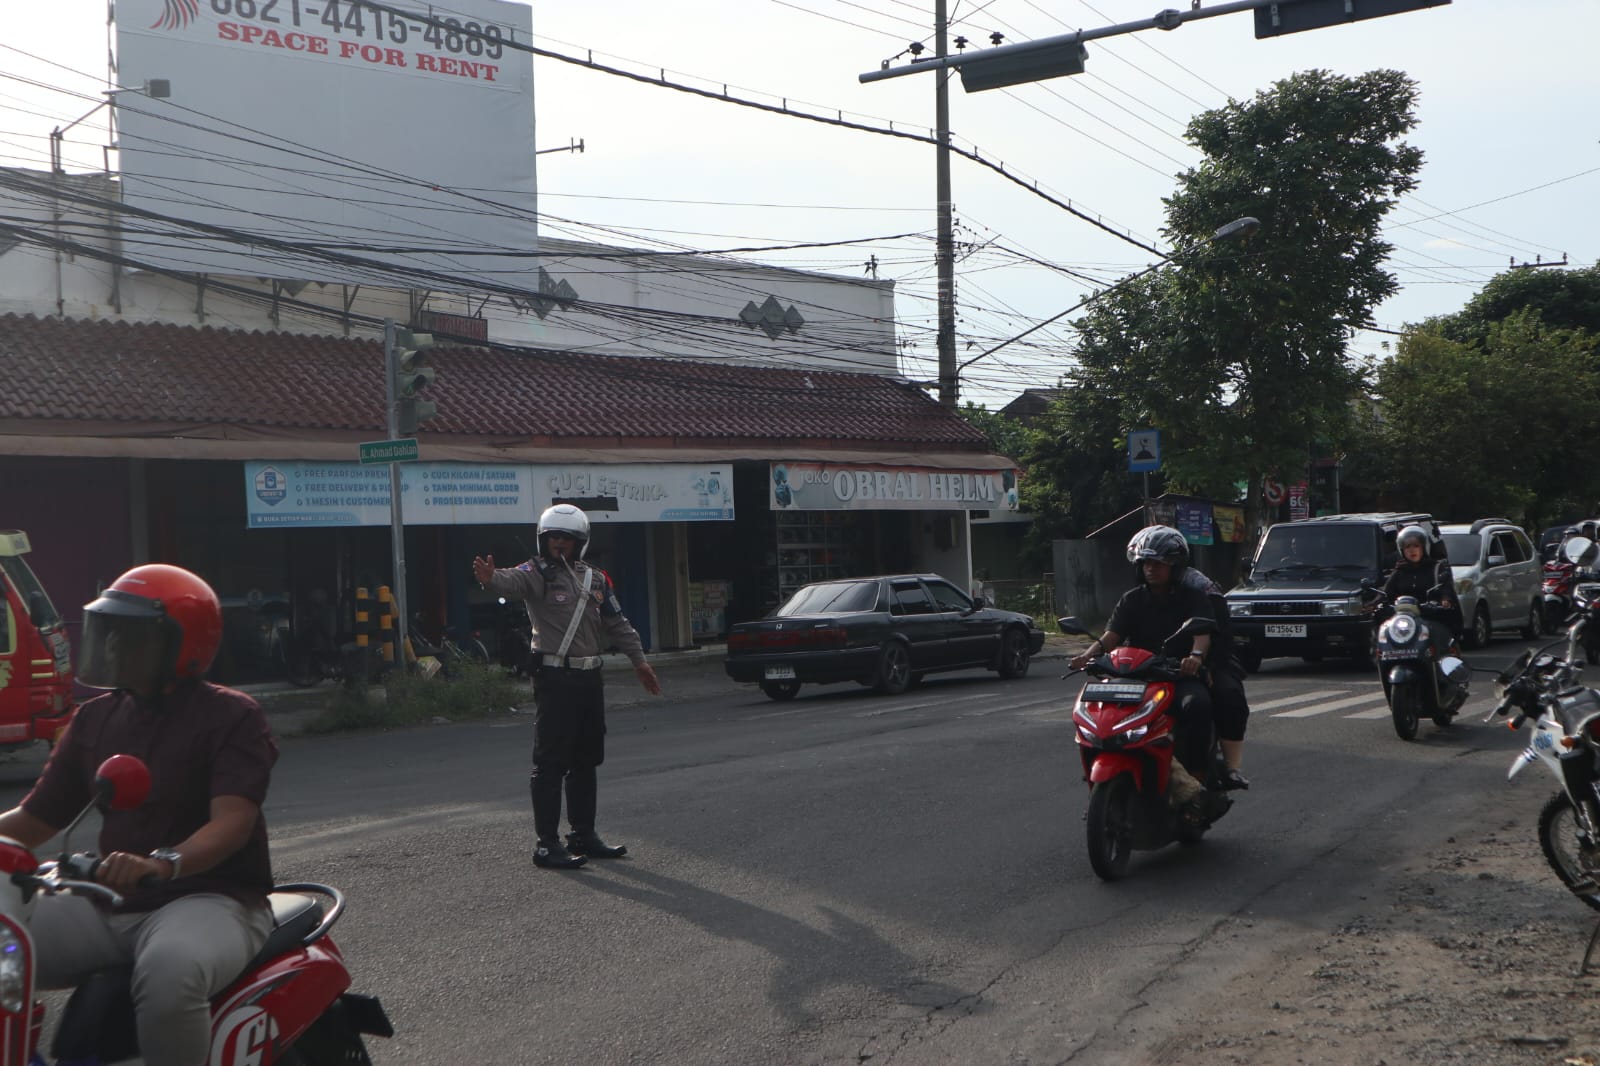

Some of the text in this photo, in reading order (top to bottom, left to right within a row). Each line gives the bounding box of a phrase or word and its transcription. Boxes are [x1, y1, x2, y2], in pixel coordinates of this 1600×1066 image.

[217, 21, 499, 81] SPACE FOR RENT
[304, 471, 327, 479] FREE
[431, 471, 450, 480] CUCI
[451, 471, 480, 480] KILOAN
[486, 471, 516, 480] SATUAN
[305, 483, 327, 492] FREE
[328, 483, 369, 493] DELIVERY
[432, 483, 519, 493] TANPA MINIMAL ORDER
[547, 471, 668, 501] CUCI SETRIKA
[833, 470, 922, 501] OBRAL
[928, 472, 995, 502] HELM
[433, 496, 518, 505] PROSES DIAWASI CCTV
